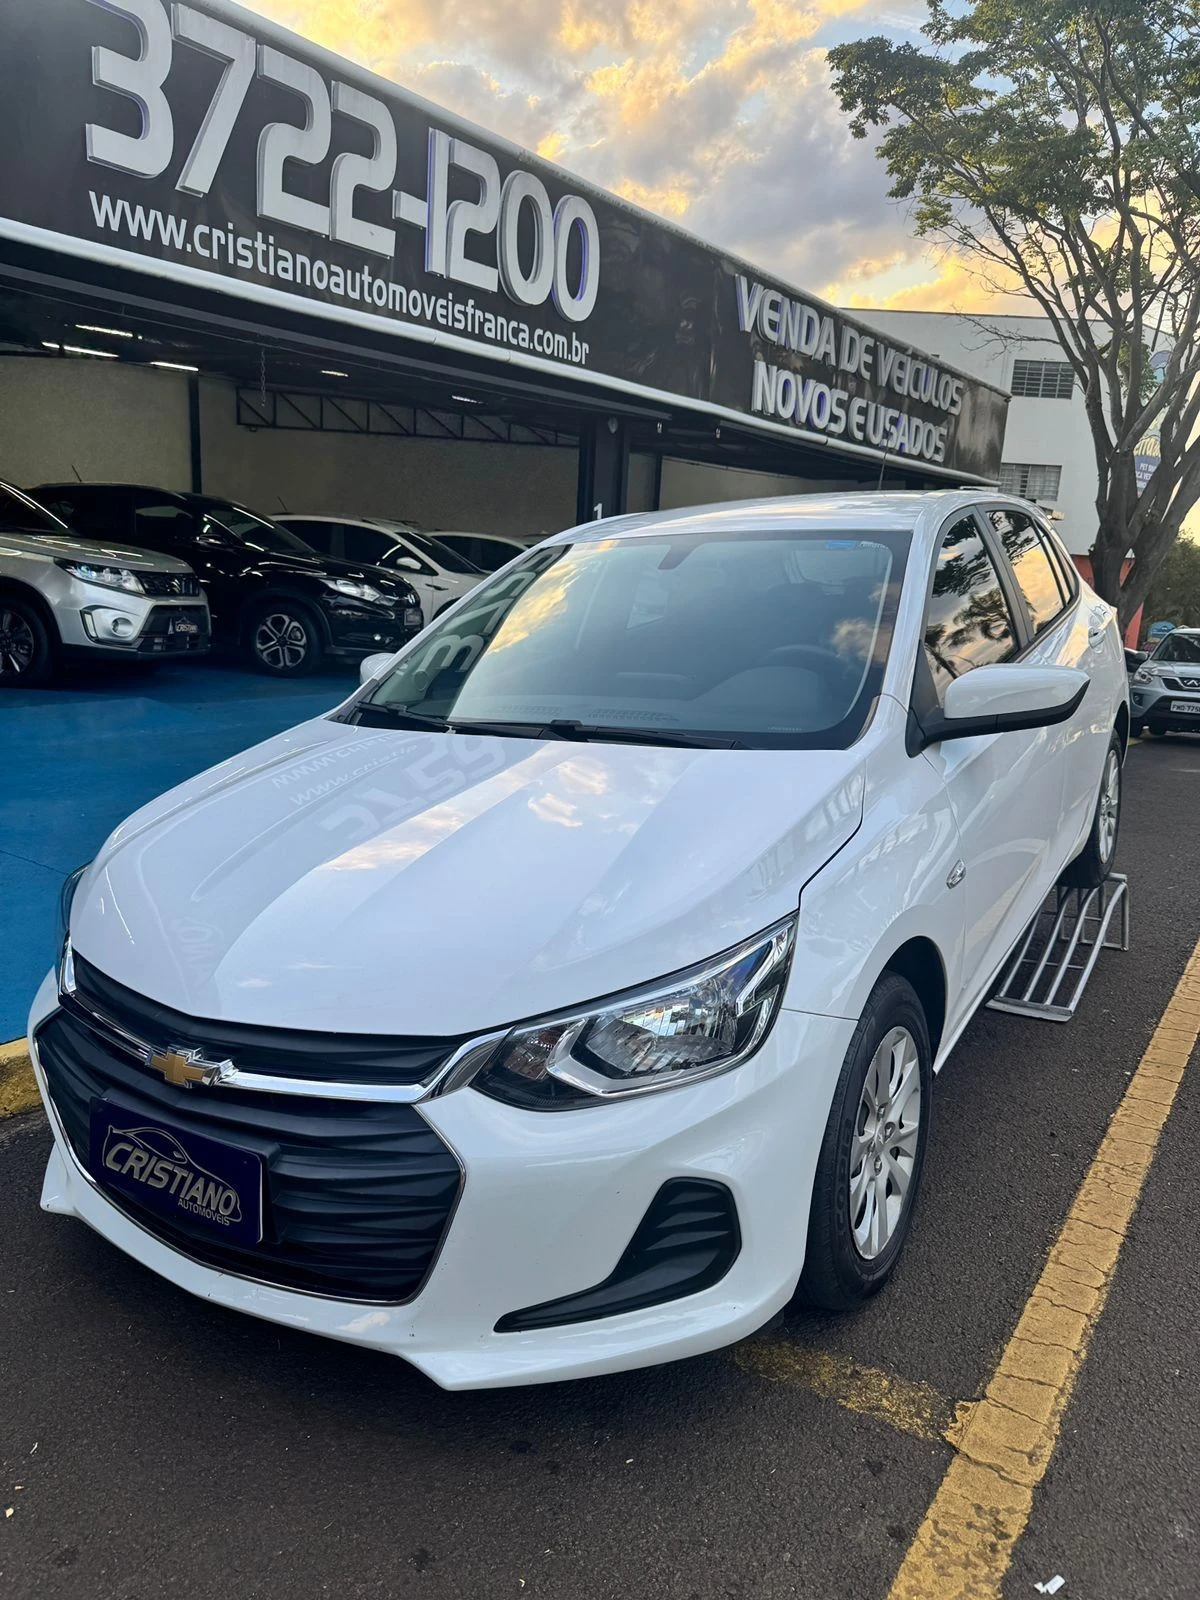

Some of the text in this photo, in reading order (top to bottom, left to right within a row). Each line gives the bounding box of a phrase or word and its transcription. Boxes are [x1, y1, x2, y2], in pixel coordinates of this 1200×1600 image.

[85, 0, 600, 322] 3722-1200
[88, 190, 590, 365] www.cristianoautomoveisfranca.com.br
[735, 273, 837, 367] VENDA
[838, 325, 875, 380] DE
[751, 360, 948, 464] NOVOS E USADOS
[105, 1142, 235, 1216] CRISTIANO
